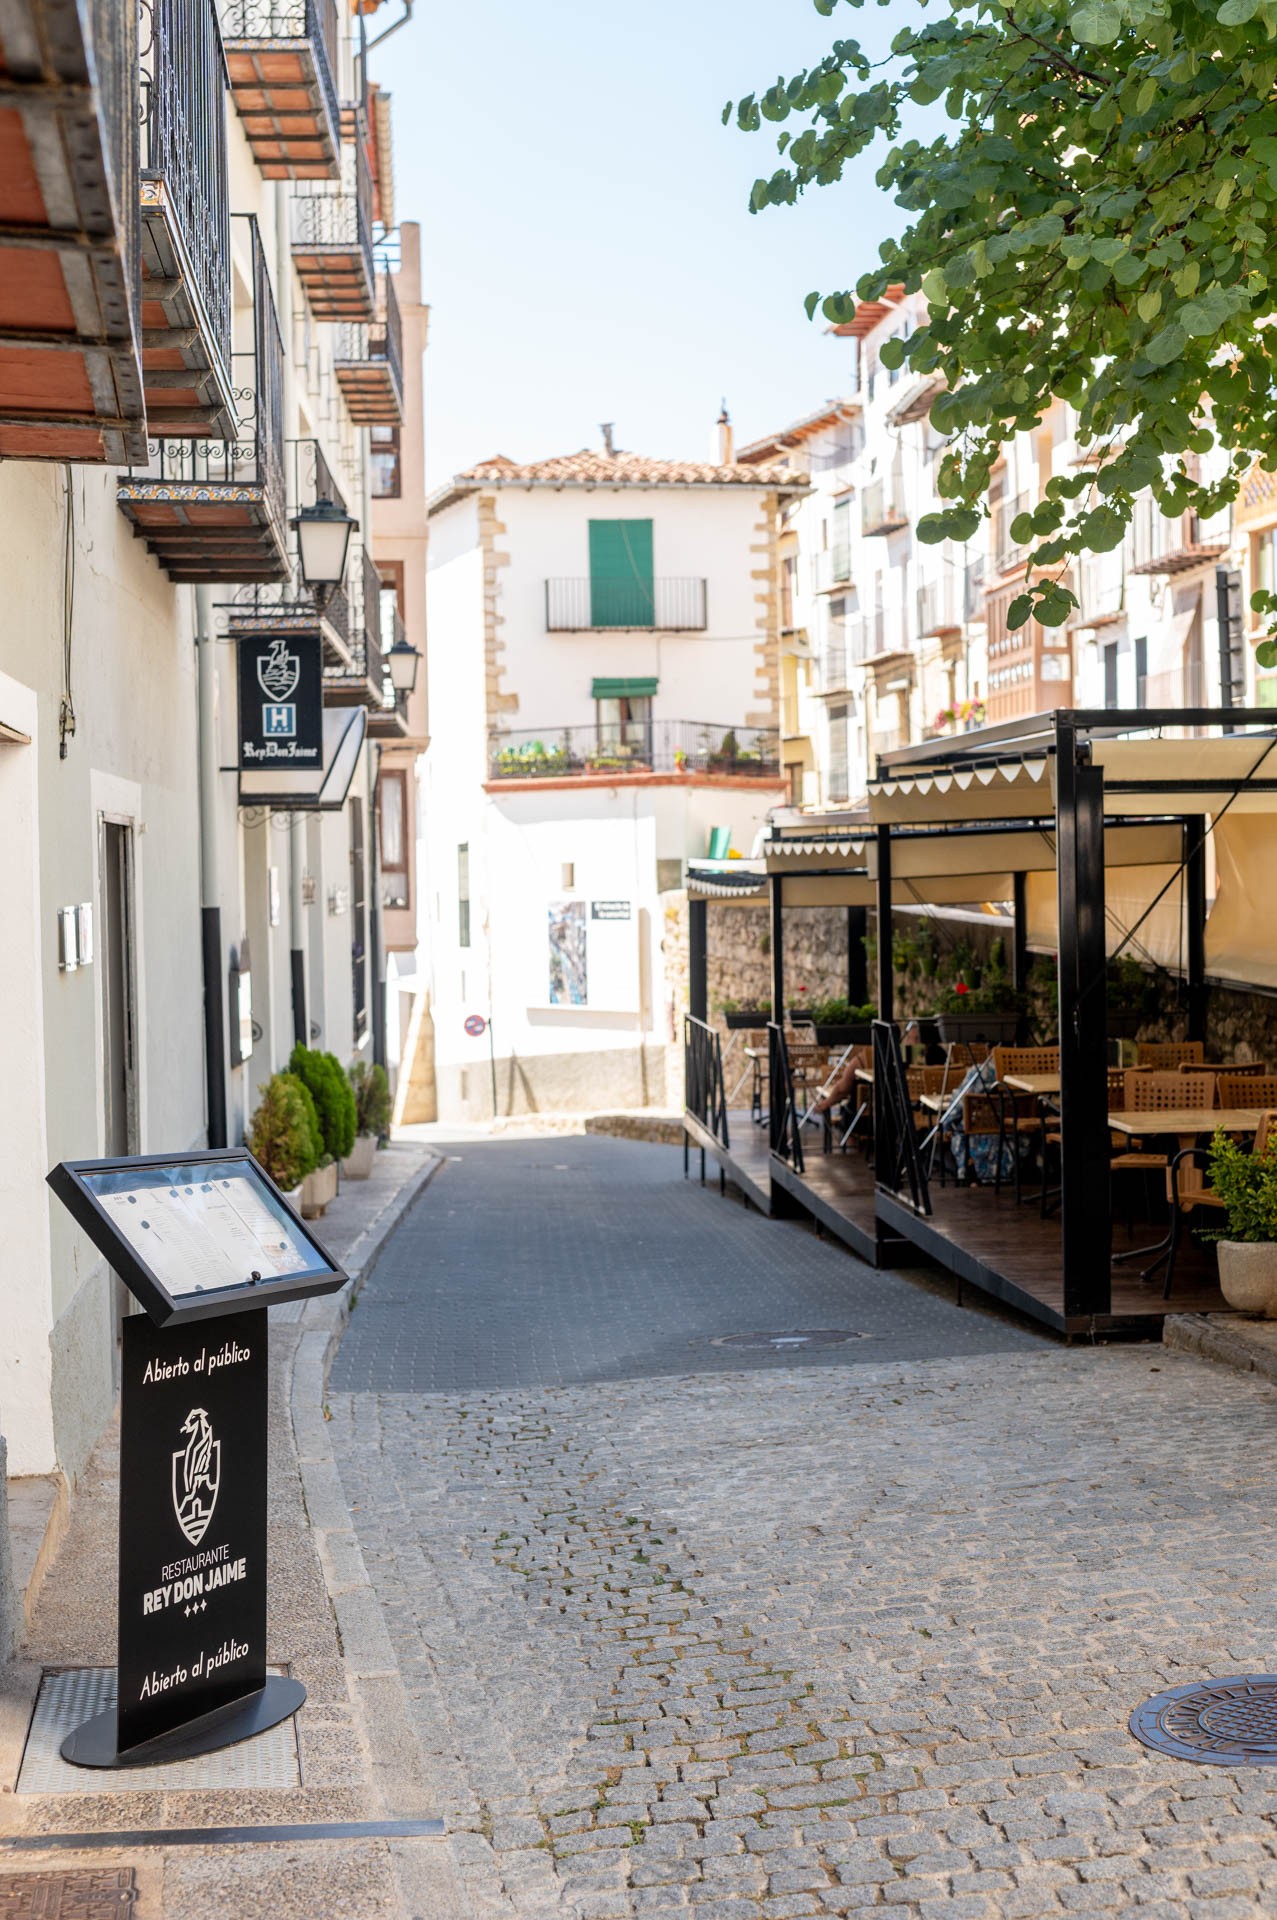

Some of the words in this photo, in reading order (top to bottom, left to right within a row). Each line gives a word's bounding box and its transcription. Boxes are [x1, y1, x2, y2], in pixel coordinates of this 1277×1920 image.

[271, 707, 288, 727] H
[143, 1356, 190, 1385] Abierto
[193, 1347, 206, 1373] al
[207, 1340, 251, 1377] público
[161, 1543, 230, 1582] RESTAURANTE
[143, 1583, 172, 1616] REY
[173, 1572, 204, 1602] DON
[204, 1557, 247, 1592] JAIME
[139, 1664, 188, 1701] Abierto
[191, 1650, 204, 1678] al
[206, 1638, 249, 1679] público
